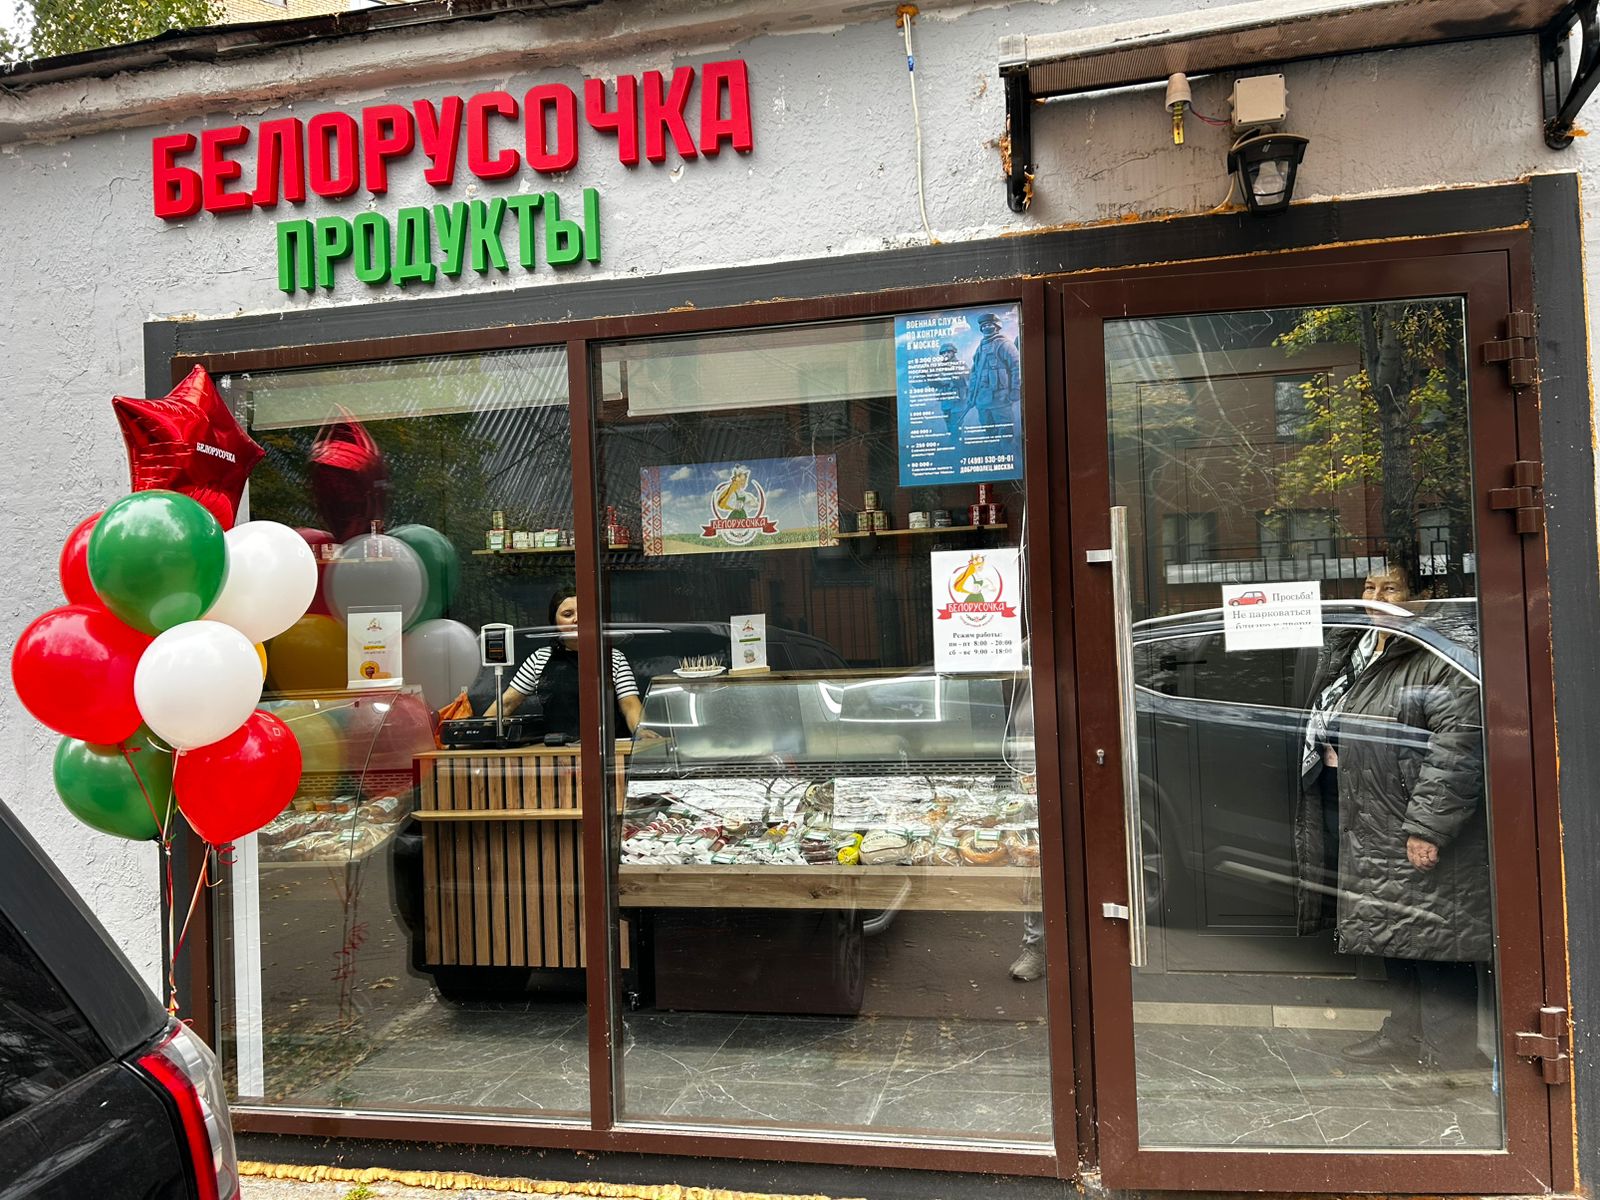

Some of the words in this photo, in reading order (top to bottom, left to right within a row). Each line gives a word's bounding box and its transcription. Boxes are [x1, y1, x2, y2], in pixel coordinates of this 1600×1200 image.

[152, 59, 753, 219] БЕЛОРУСОЧКА
[277, 187, 601, 293] ПРОДУКТЫ
[906, 319, 937, 329] ВОЕННАЯ
[937, 316, 967, 327] СЛУЖБА
[906, 331, 916, 340] ПО
[916, 328, 955, 339] КОНТРАКТУ
[906, 342, 911, 350] В
[912, 340, 940, 350] МОСКВЕ
[196, 442, 236, 463] БЕЛОРУСОЧКА
[712, 518, 766, 529] БЕЛОРУСОЧКА
[1272, 591, 1314, 602] Просьба!
[948, 602, 1005, 612] БЕЛОРУСОЧКА
[1232, 610, 1247, 619] Не
[1249, 609, 1311, 620] парковаться
